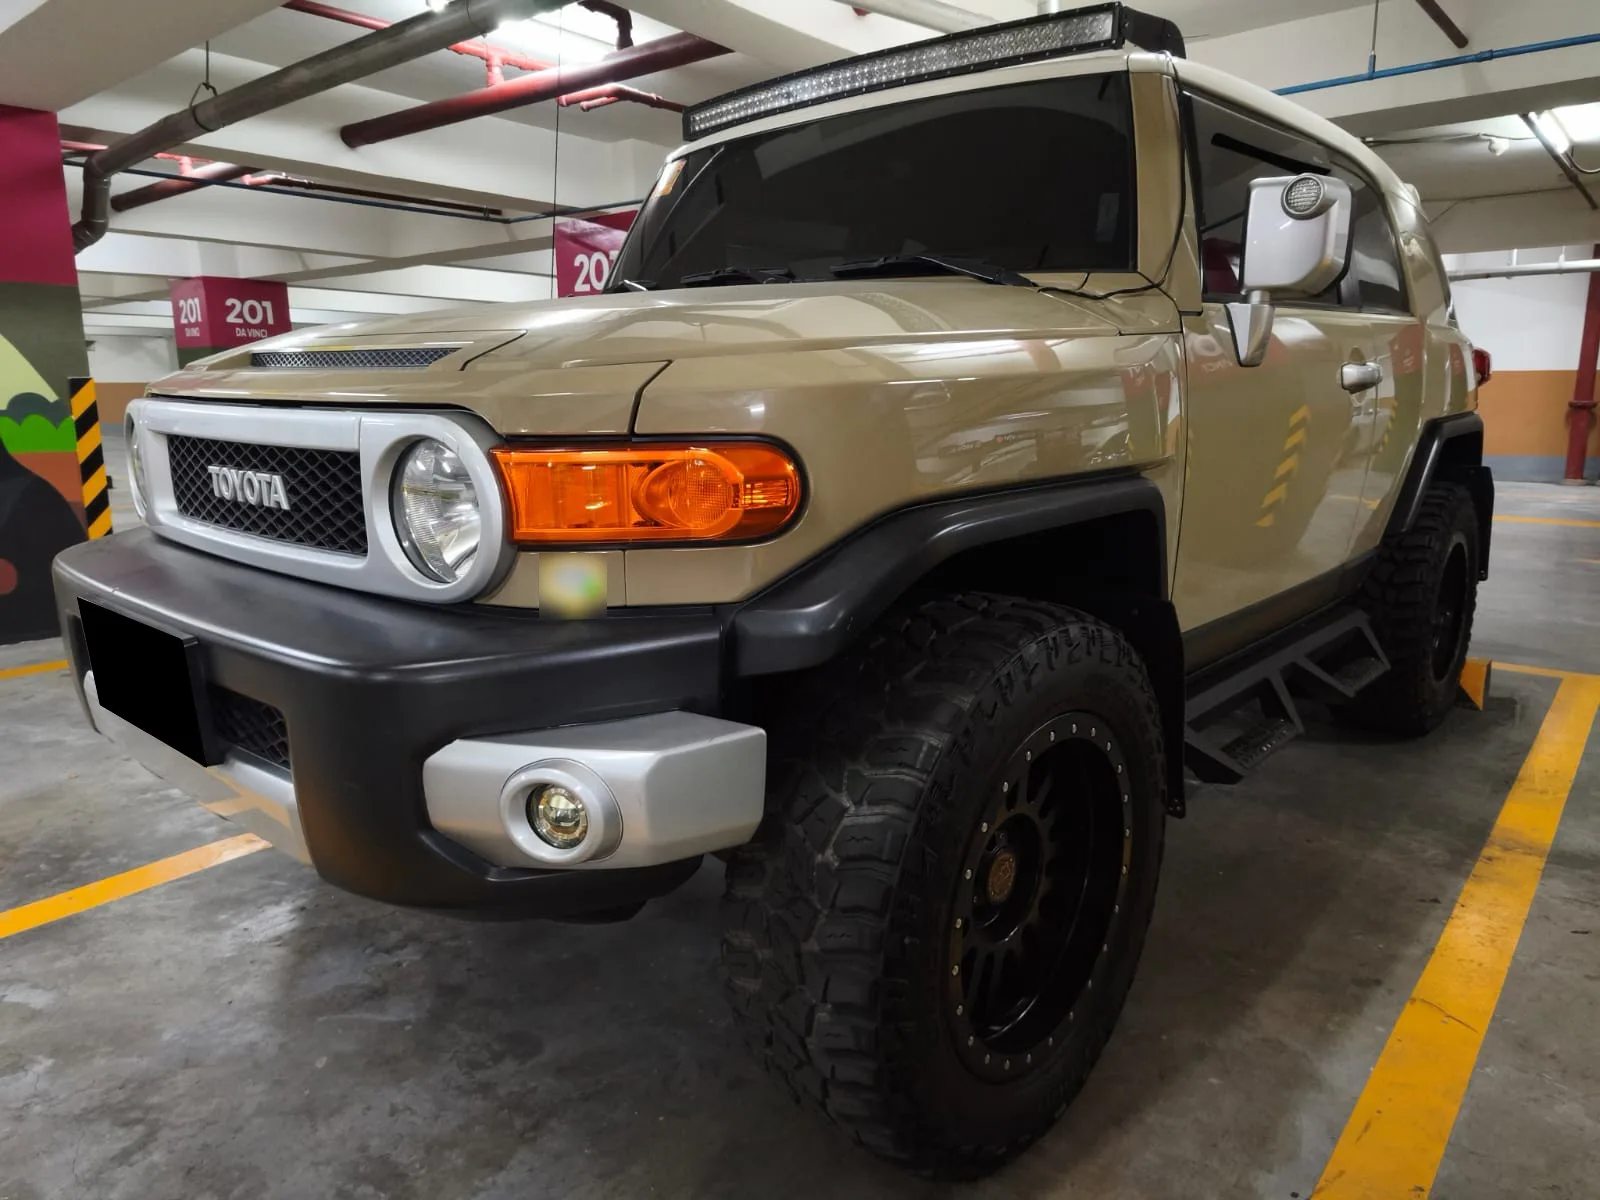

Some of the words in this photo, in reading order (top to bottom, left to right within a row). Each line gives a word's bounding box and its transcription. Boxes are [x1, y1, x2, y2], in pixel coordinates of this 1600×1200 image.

[178, 297, 202, 324] 201
[225, 298, 274, 325] 201
[235, 327, 247, 337] DA
[207, 465, 290, 511] TOYOTA
